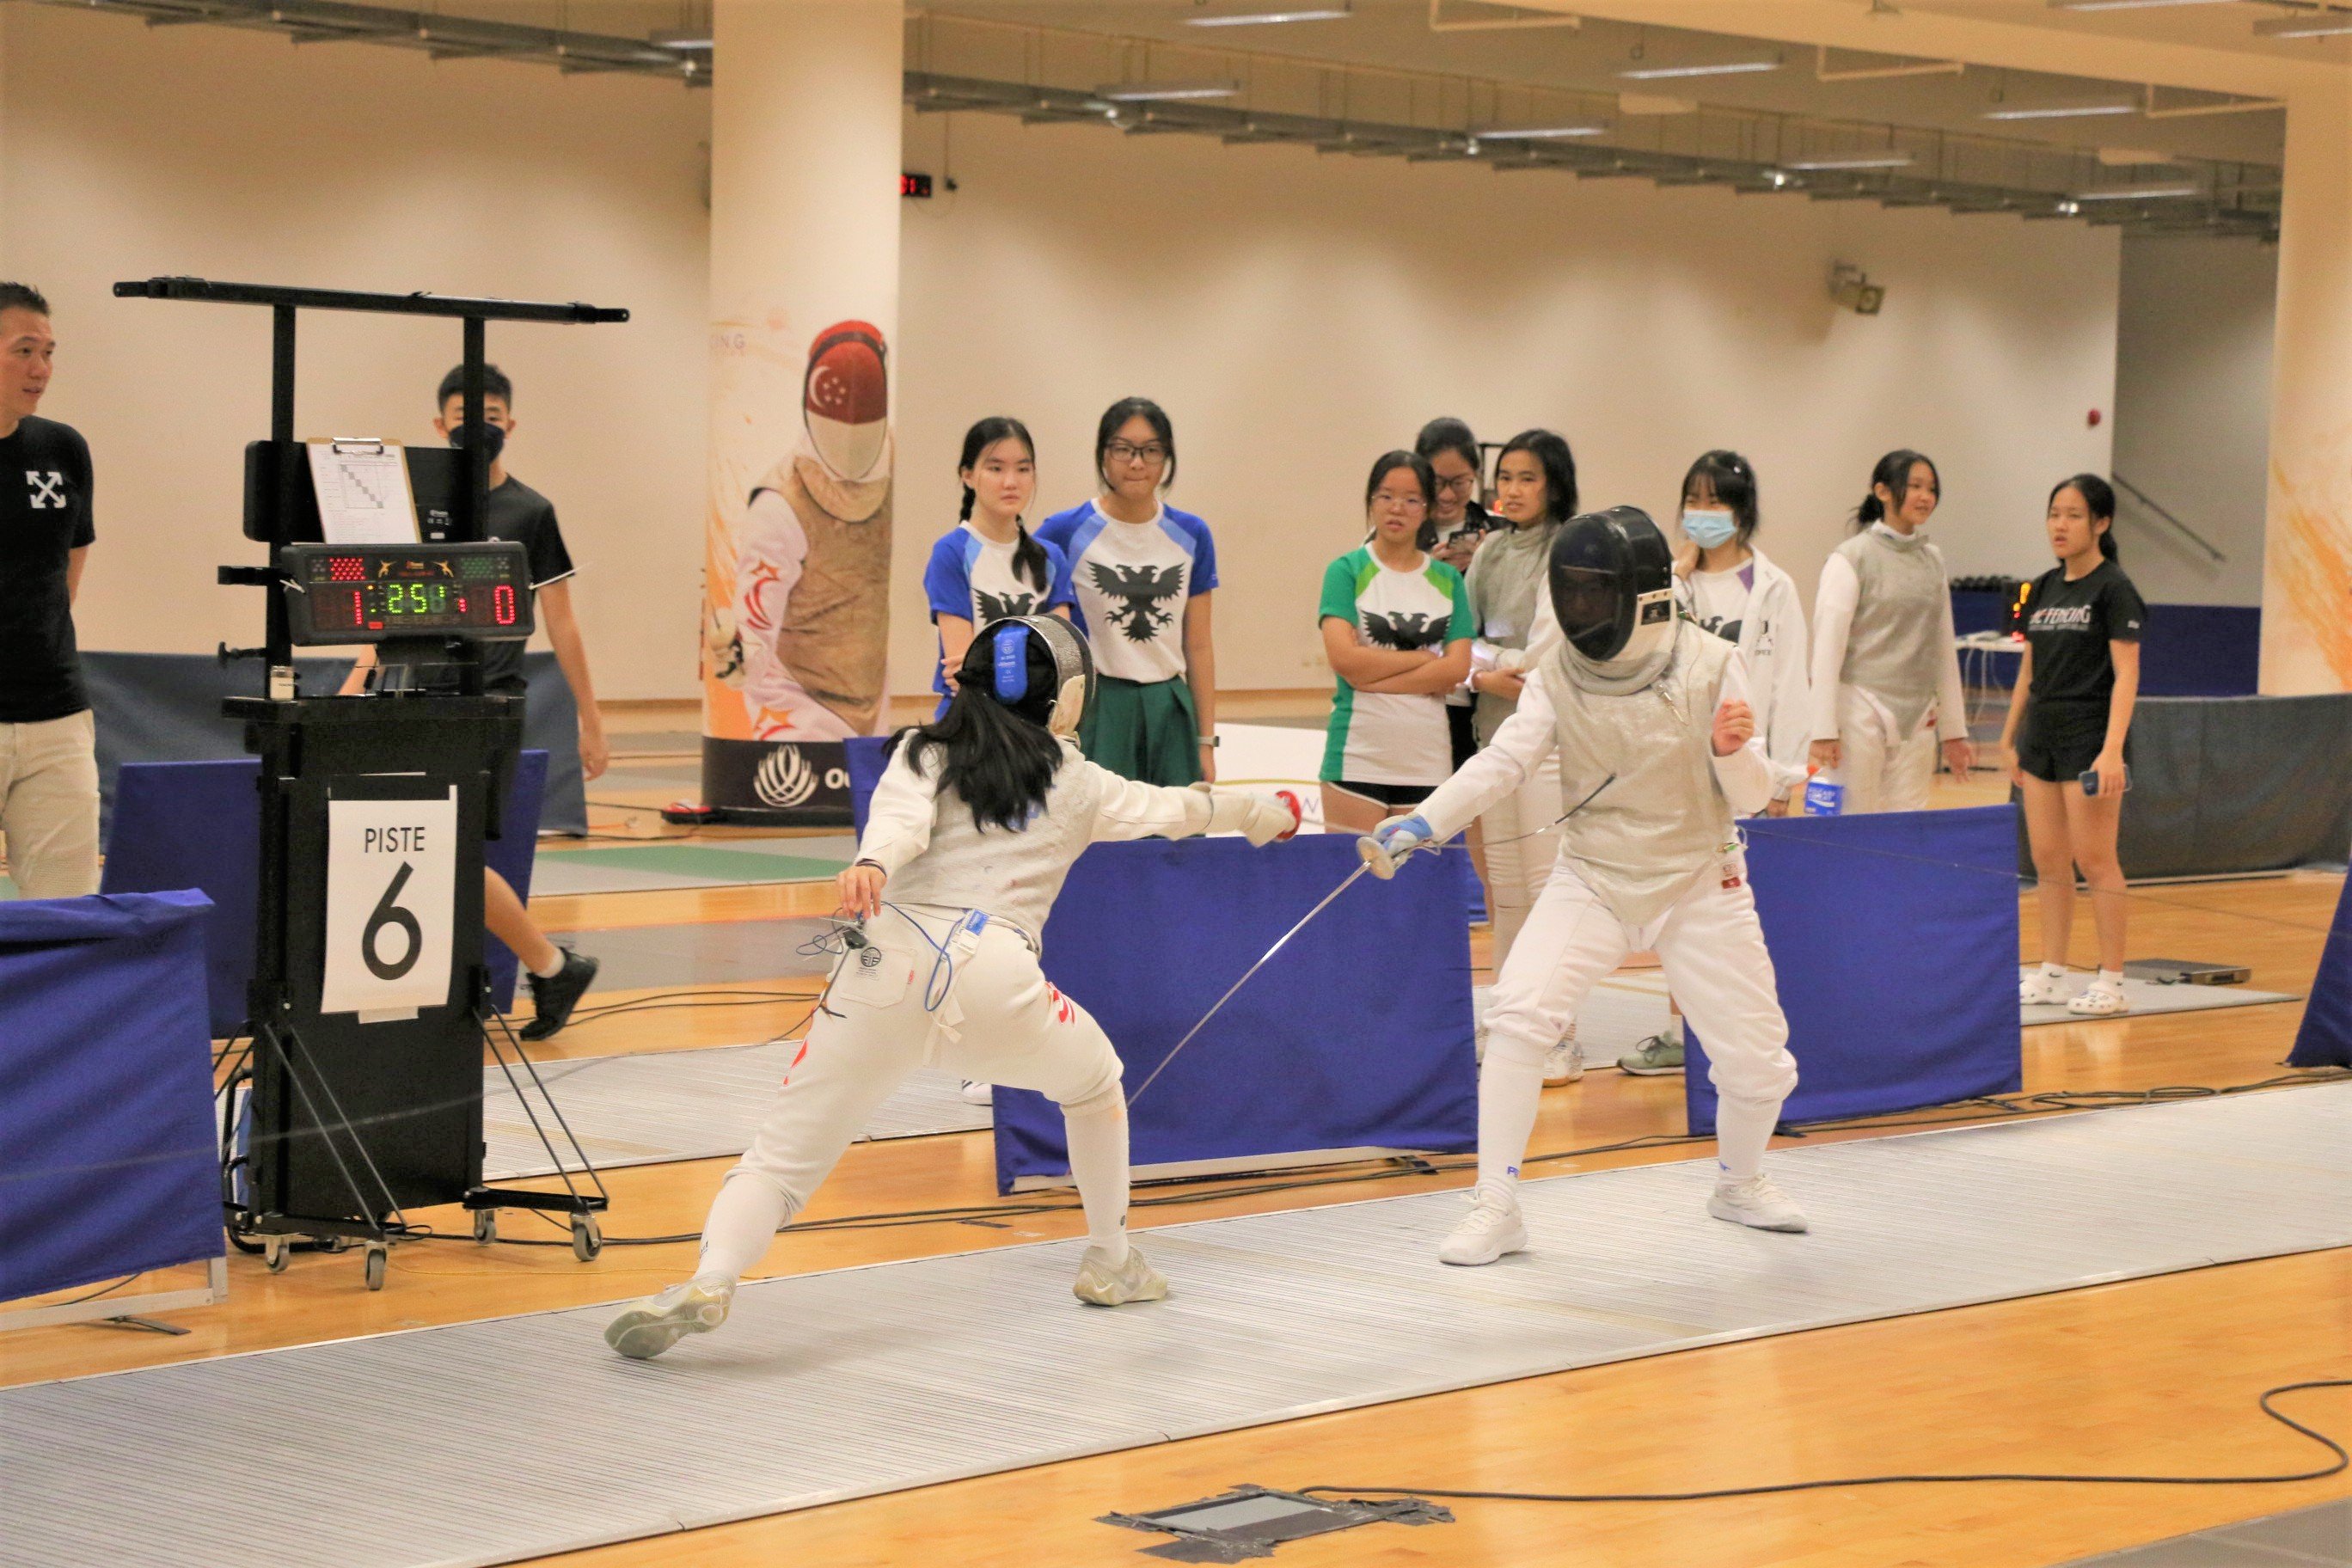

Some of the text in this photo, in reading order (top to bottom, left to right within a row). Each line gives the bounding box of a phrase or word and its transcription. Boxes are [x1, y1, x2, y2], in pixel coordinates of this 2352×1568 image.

[493, 585, 516, 625] 0
[364, 826, 426, 854] PISTE
[362, 861, 423, 981] 6
